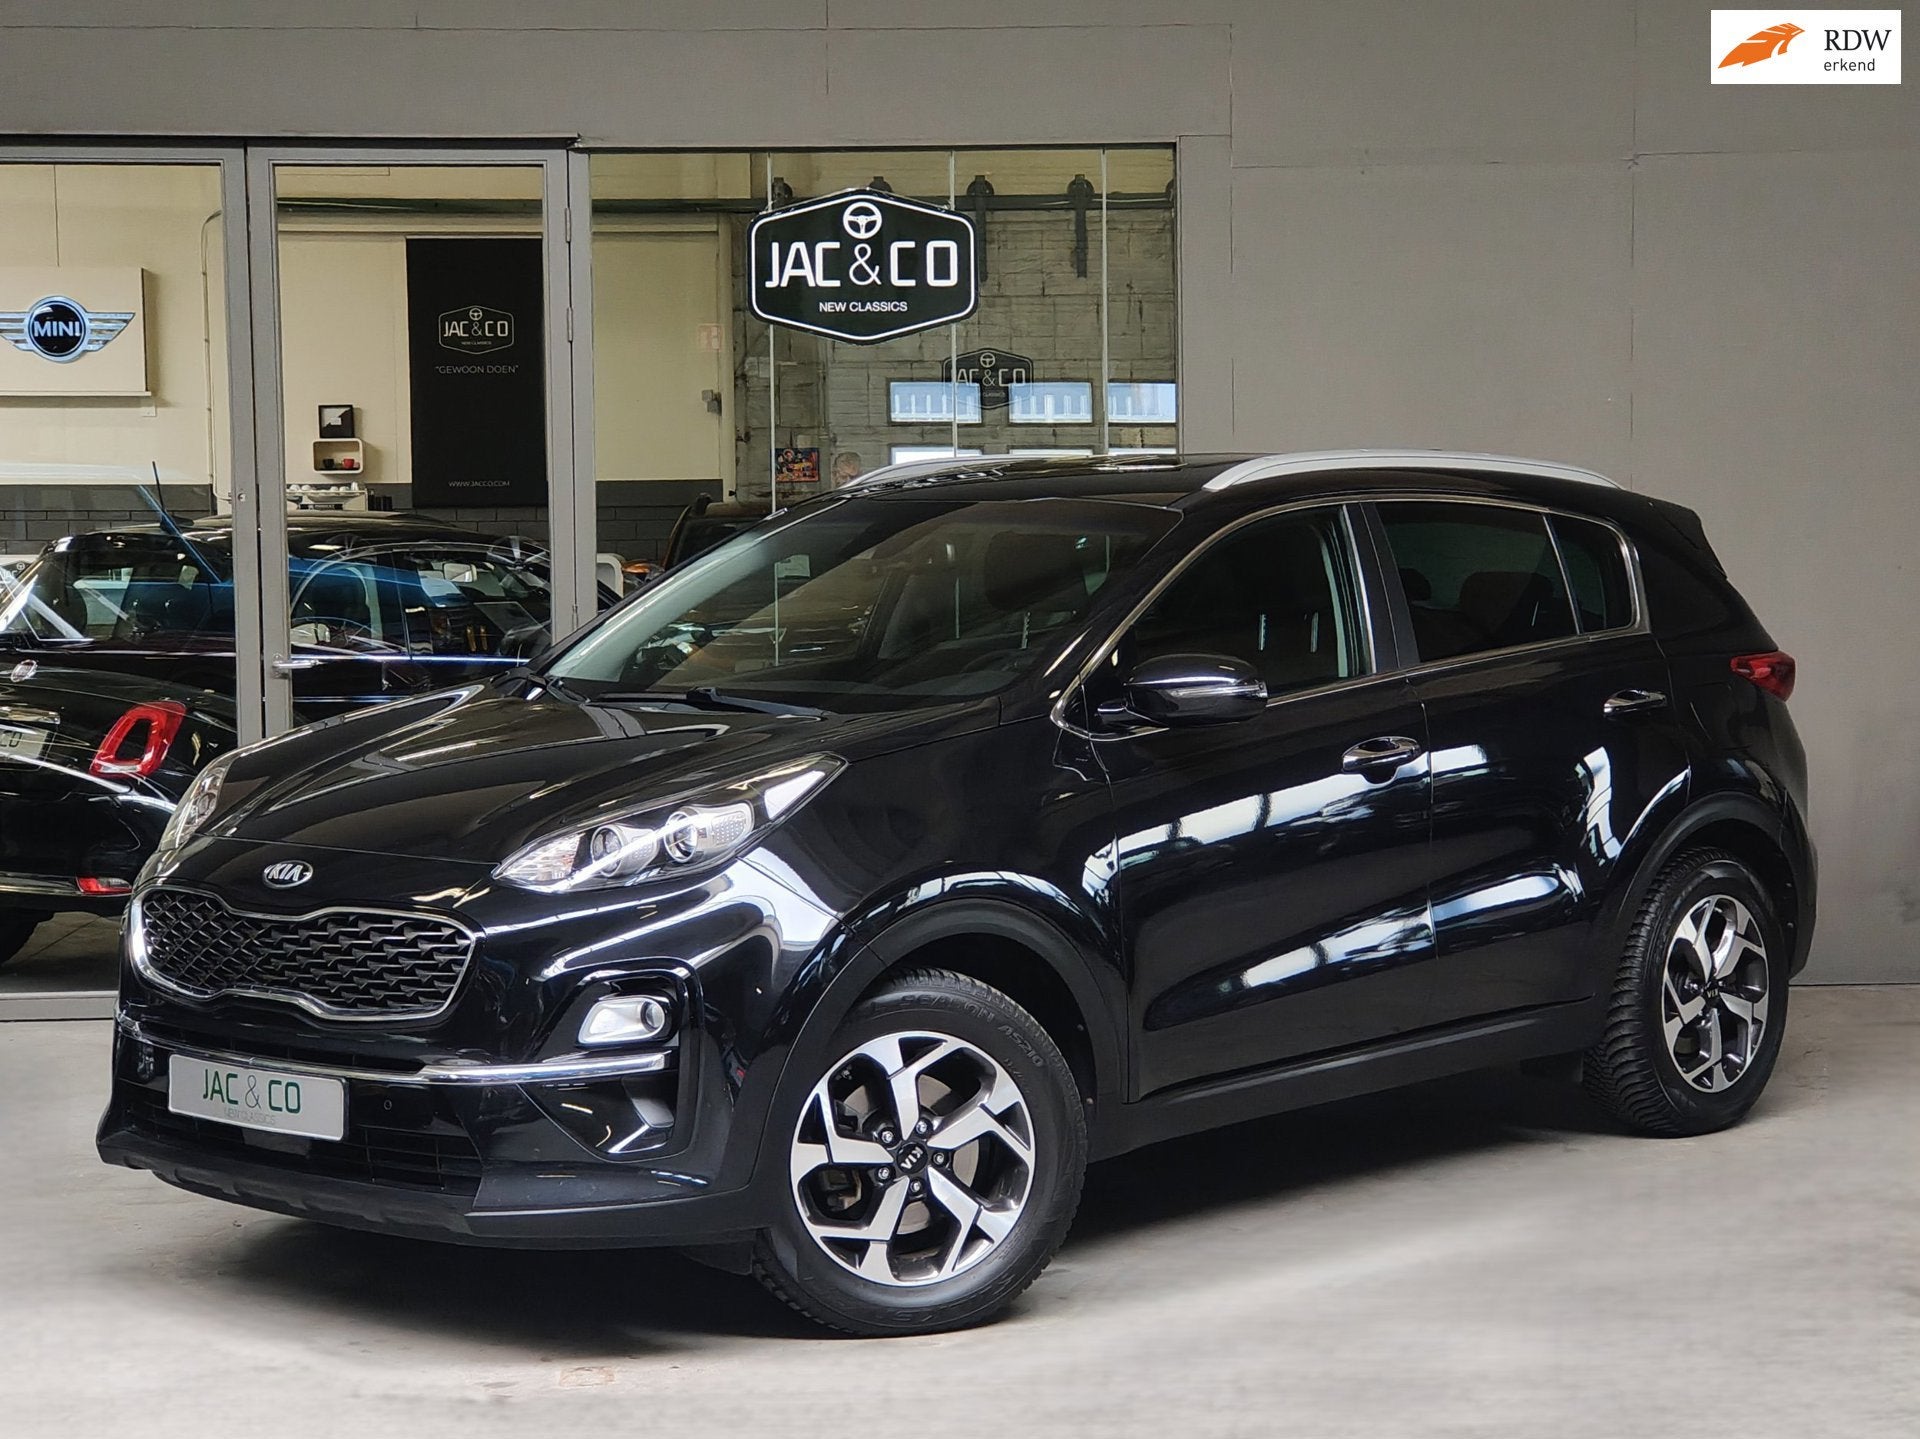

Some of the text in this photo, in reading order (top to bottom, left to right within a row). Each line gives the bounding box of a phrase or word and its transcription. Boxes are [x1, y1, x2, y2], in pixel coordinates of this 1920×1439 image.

[765, 240, 958, 288] JAC & CO
[819, 301, 908, 312] NEW CLASSICS
[33, 321, 81, 337] MINI
[443, 320, 508, 337] JAC & CO
[956, 368, 1026, 386] AC & CO
[268, 863, 304, 881] KIA
[203, 1068, 301, 1114] JAC & CO
[900, 1146, 924, 1169] KIA
